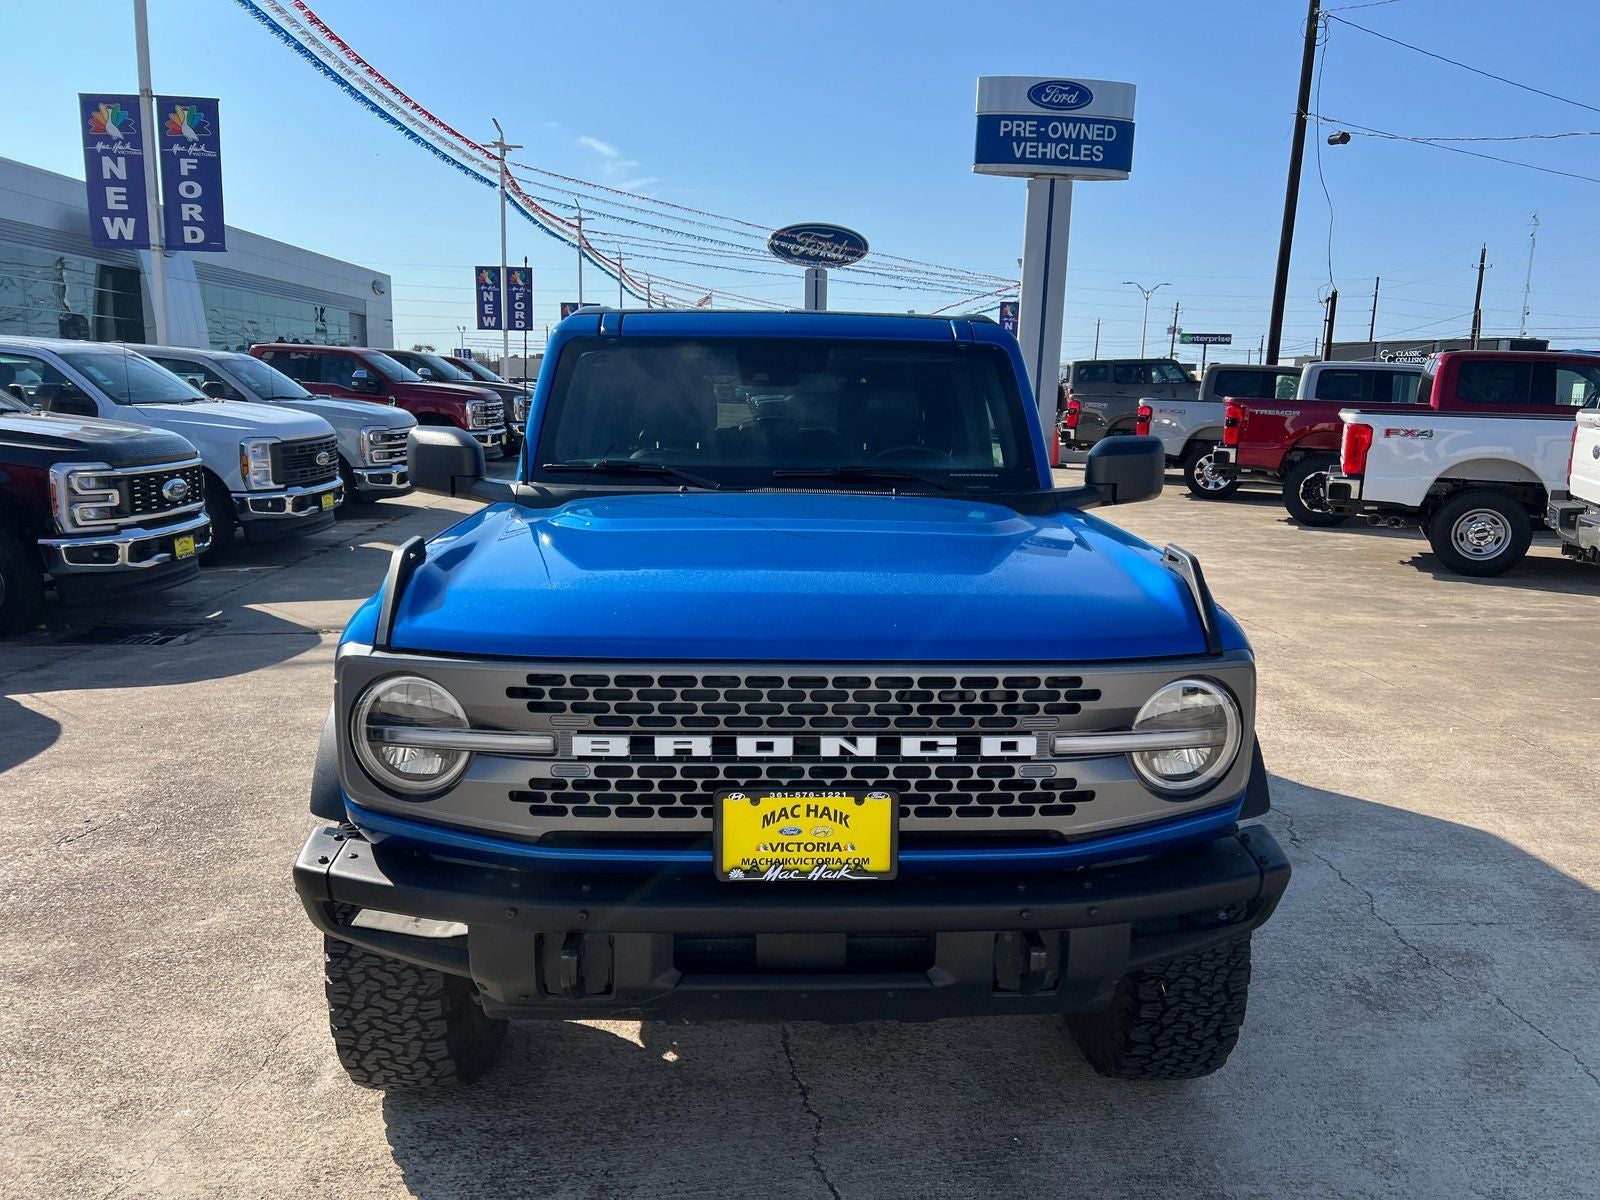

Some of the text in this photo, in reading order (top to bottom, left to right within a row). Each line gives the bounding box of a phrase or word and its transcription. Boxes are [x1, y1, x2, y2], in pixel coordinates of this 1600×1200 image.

[1041, 85, 1079, 104] Ford
[1000, 120, 1117, 142] PRE-OWNED
[1012, 141, 1105, 162] VEHICLES
[101, 156, 135, 240] NEW
[178, 158, 205, 243] FORD
[483, 292, 496, 326] NEW
[514, 293, 525, 328] FORD
[1183, 335, 1231, 343] enterprise
[1395, 356, 1429, 364] COLLISION
[1159, 407, 1186, 416] FX4
[1253, 409, 1301, 417] TREMOR
[1384, 428, 1434, 439] FX4
[571, 735, 1038, 758] BRONCO
[761, 803, 852, 830] MAC HAIK
[768, 841, 843, 853] VICTORIA
[741, 857, 870, 866] MACHAIKVICTORIA.COM
[760, 864, 857, 882] Mac Haik
